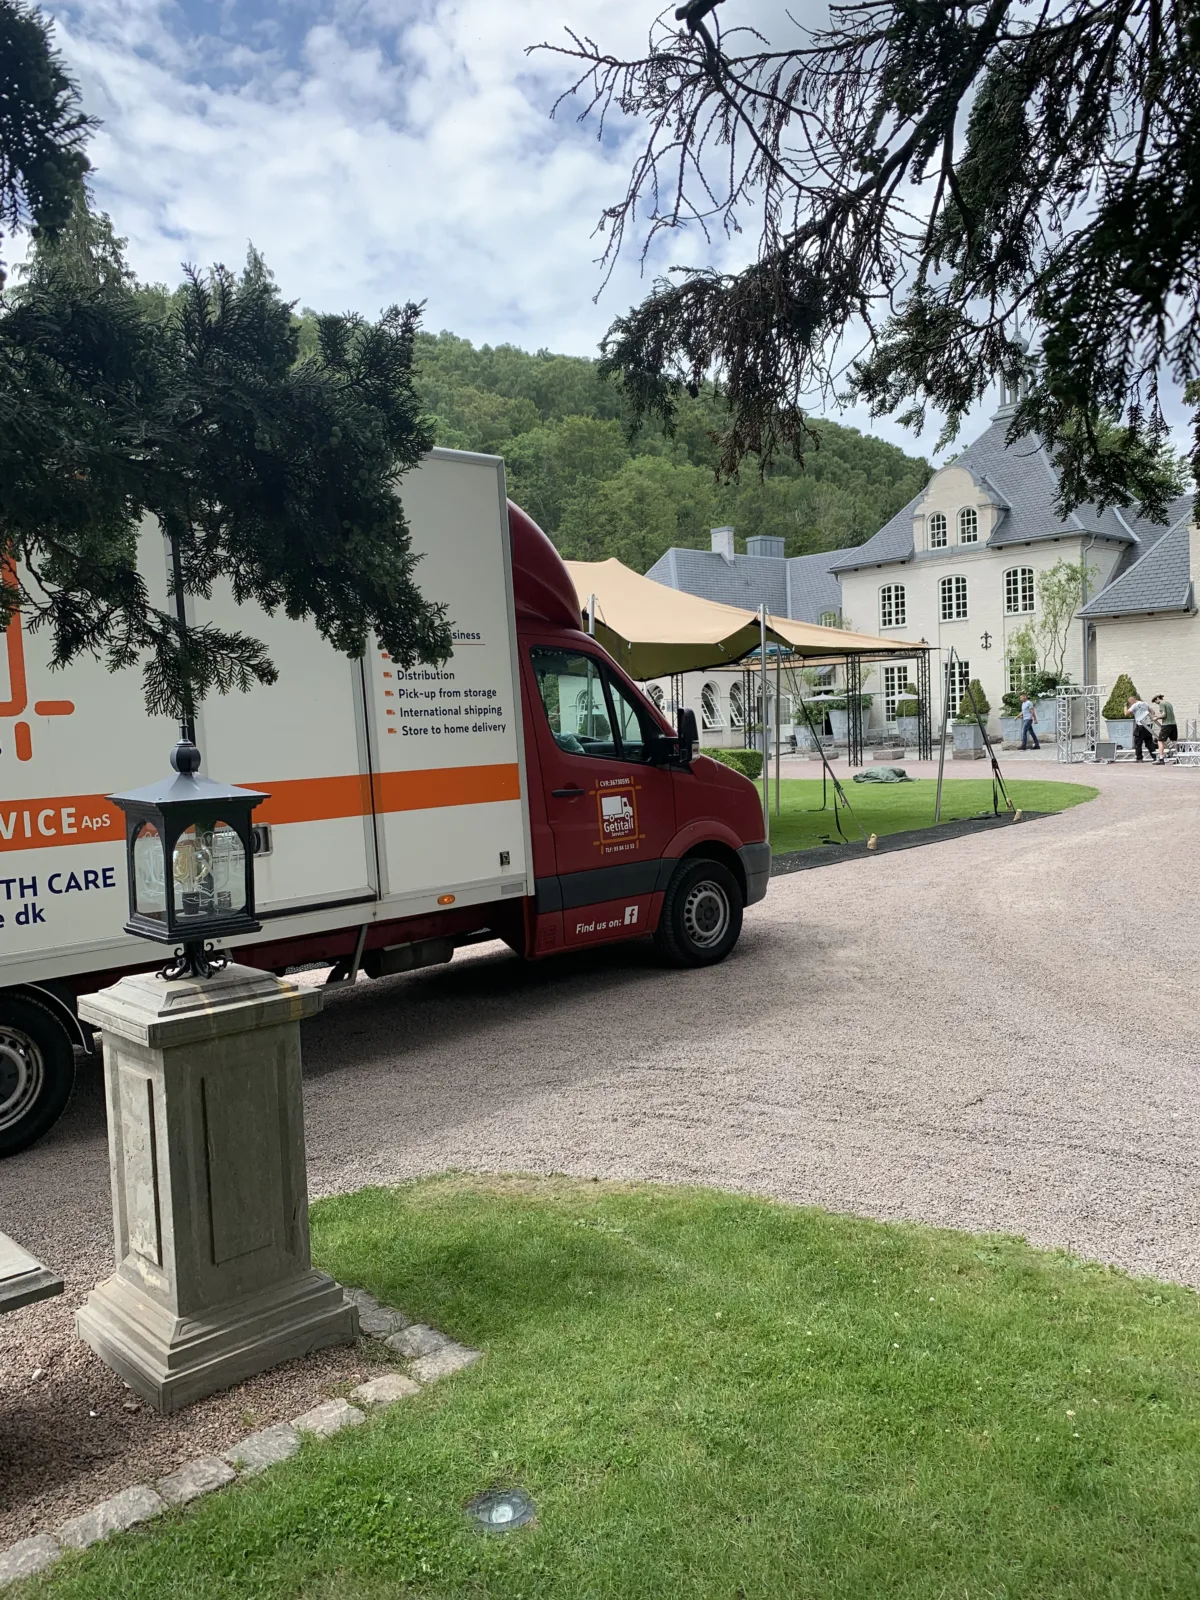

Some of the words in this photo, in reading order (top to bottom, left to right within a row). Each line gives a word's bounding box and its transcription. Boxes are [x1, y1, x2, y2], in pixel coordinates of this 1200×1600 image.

[397, 669, 455, 680] Distribution
[398, 688, 436, 700] Pick-up
[439, 688, 461, 698] from
[464, 688, 497, 699] storage
[400, 706, 461, 717] International
[464, 705, 503, 716] shipping
[402, 725, 429, 736] Store
[431, 726, 441, 735] to
[444, 724, 469, 734] home
[472, 722, 506, 733] delivery
[81, 813, 111, 831] ApS
[604, 818, 634, 833] Getitall
[47, 867, 116, 895] CARE
[576, 921, 595, 934] Find
[597, 922, 607, 930] us
[608, 919, 622, 928] on:
